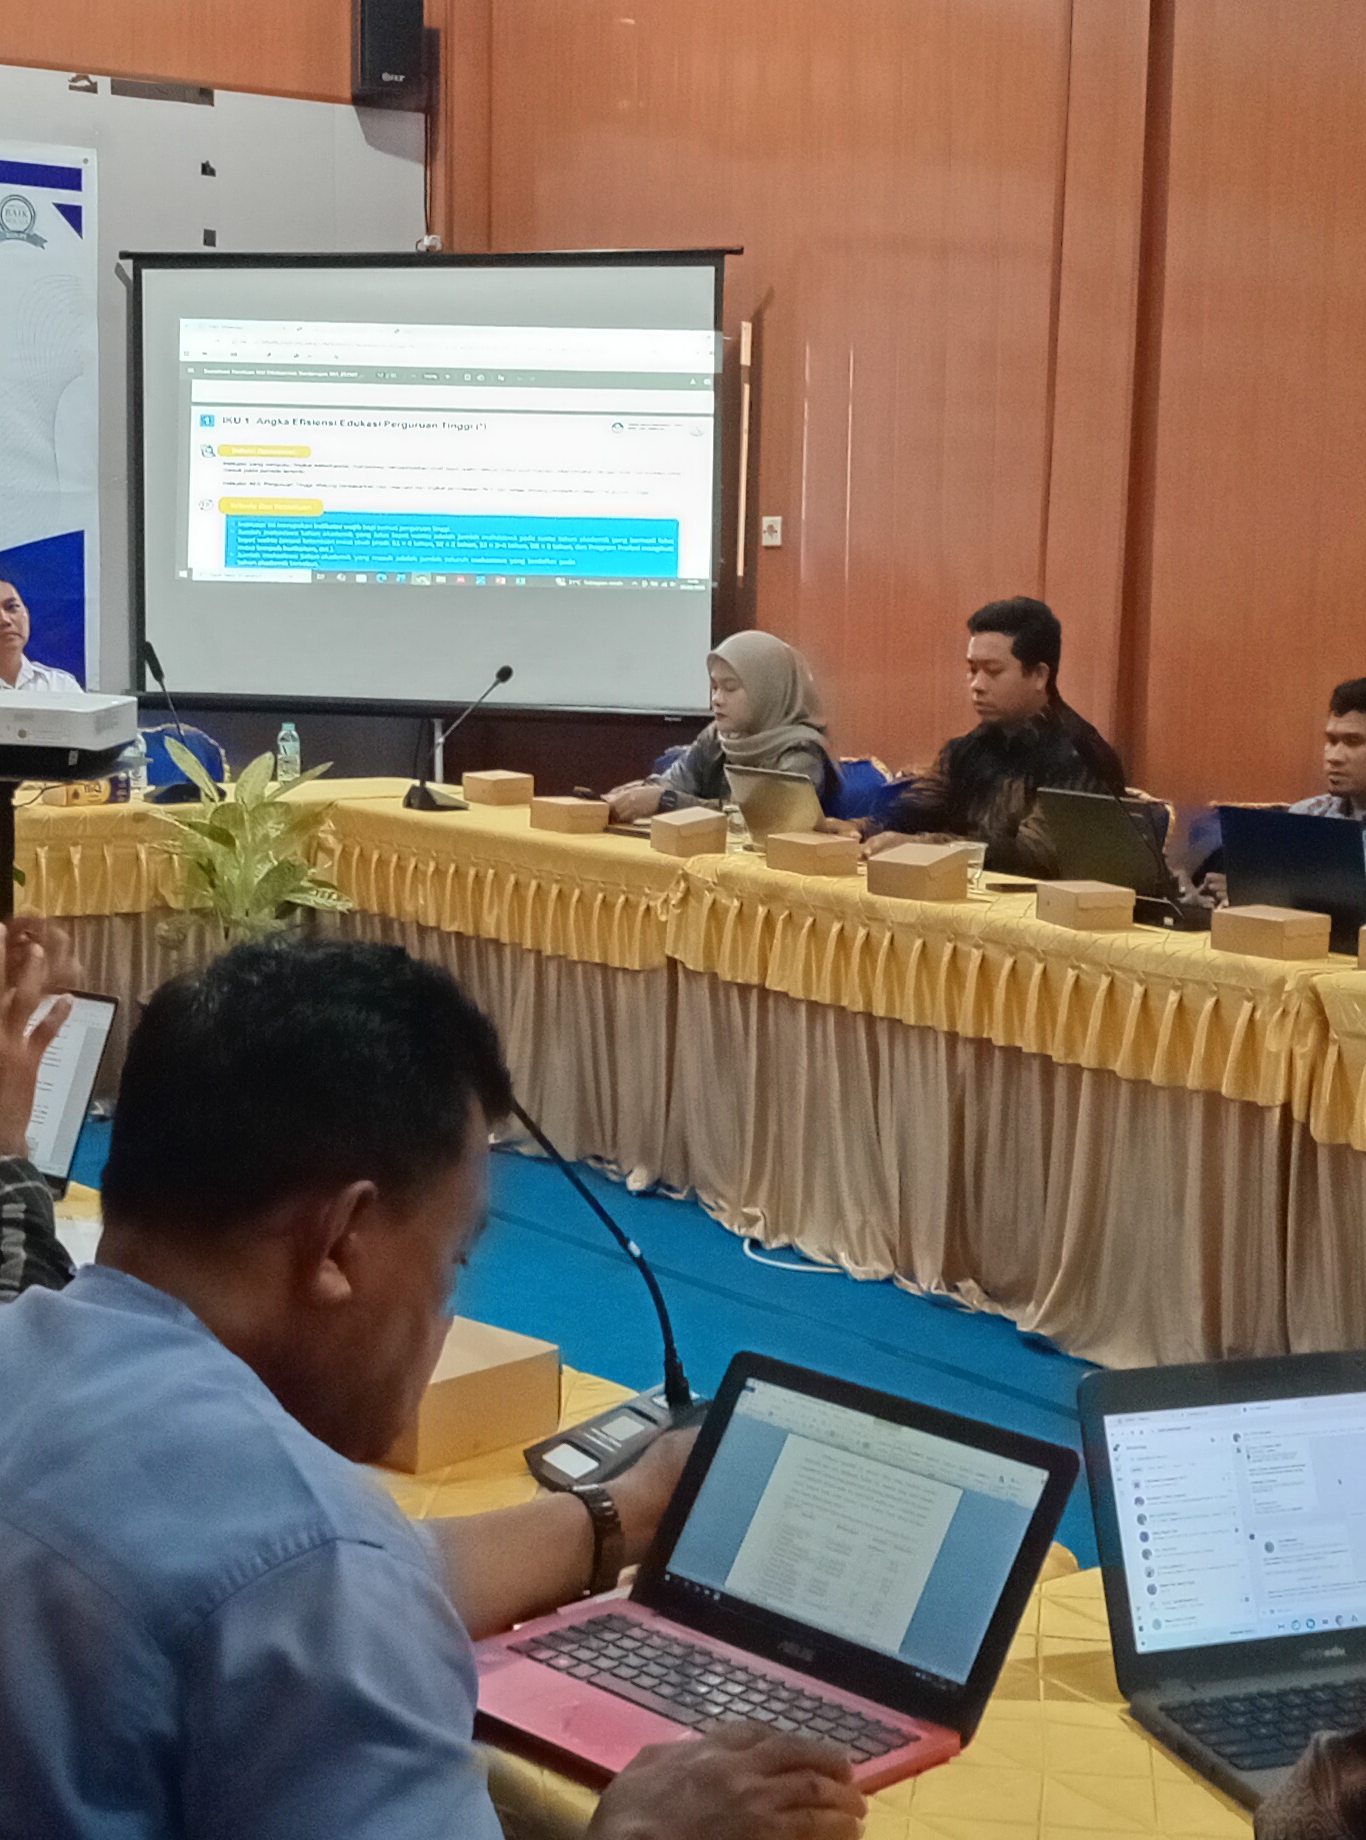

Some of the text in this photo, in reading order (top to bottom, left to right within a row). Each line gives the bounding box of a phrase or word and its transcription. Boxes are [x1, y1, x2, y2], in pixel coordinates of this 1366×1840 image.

[256, 417, 290, 427] Angka
[340, 418, 381, 428] Edukasi
[384, 420, 438, 430] Perguruan
[442, 421, 474, 431] Tinggi
